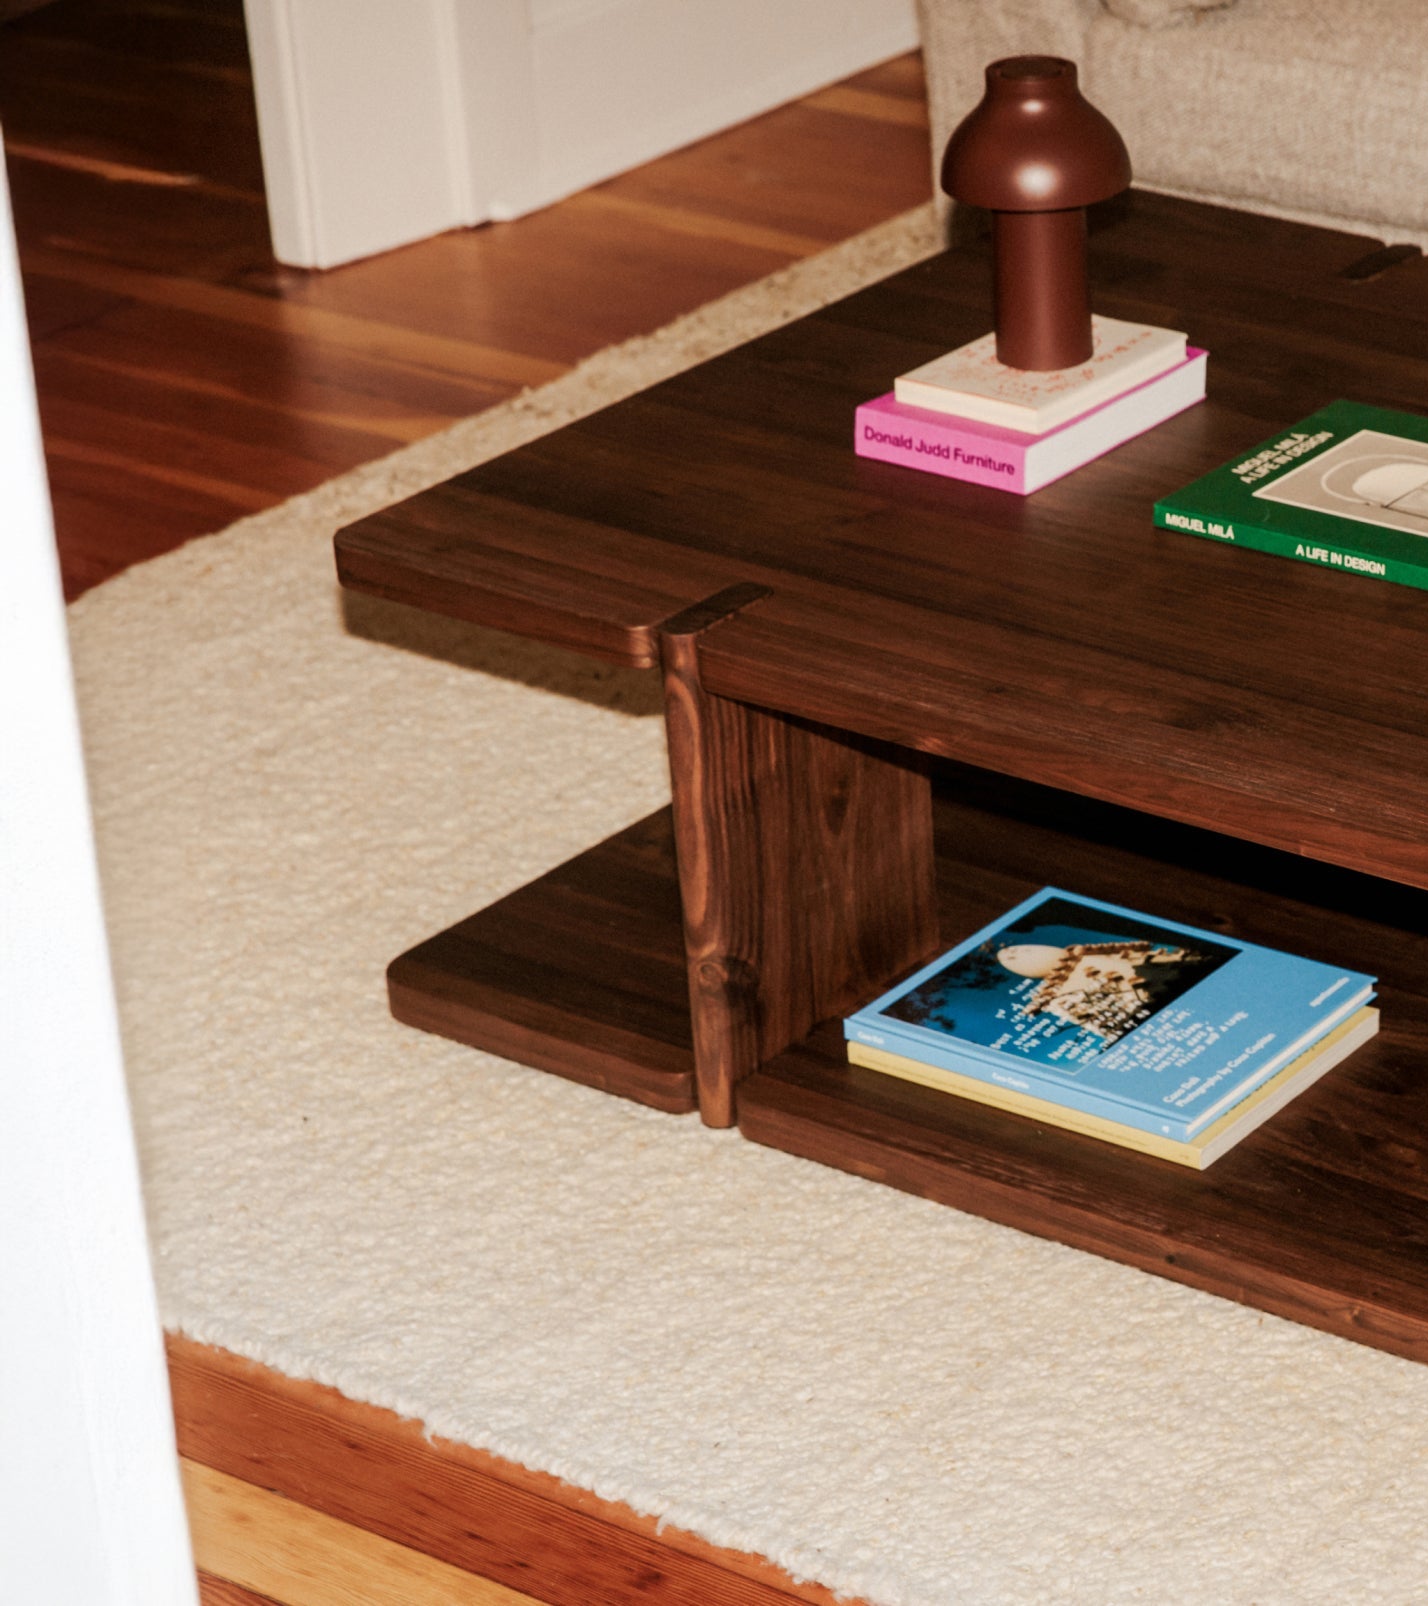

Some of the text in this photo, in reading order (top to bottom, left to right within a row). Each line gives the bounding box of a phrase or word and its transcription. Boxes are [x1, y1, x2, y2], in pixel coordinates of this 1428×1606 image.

[864, 425, 1016, 476] Donald Judd Furniture
[1165, 512, 1235, 540] MIGUEL MILÁ
[1295, 544, 1386, 576] A LIFE IN DESIGN
